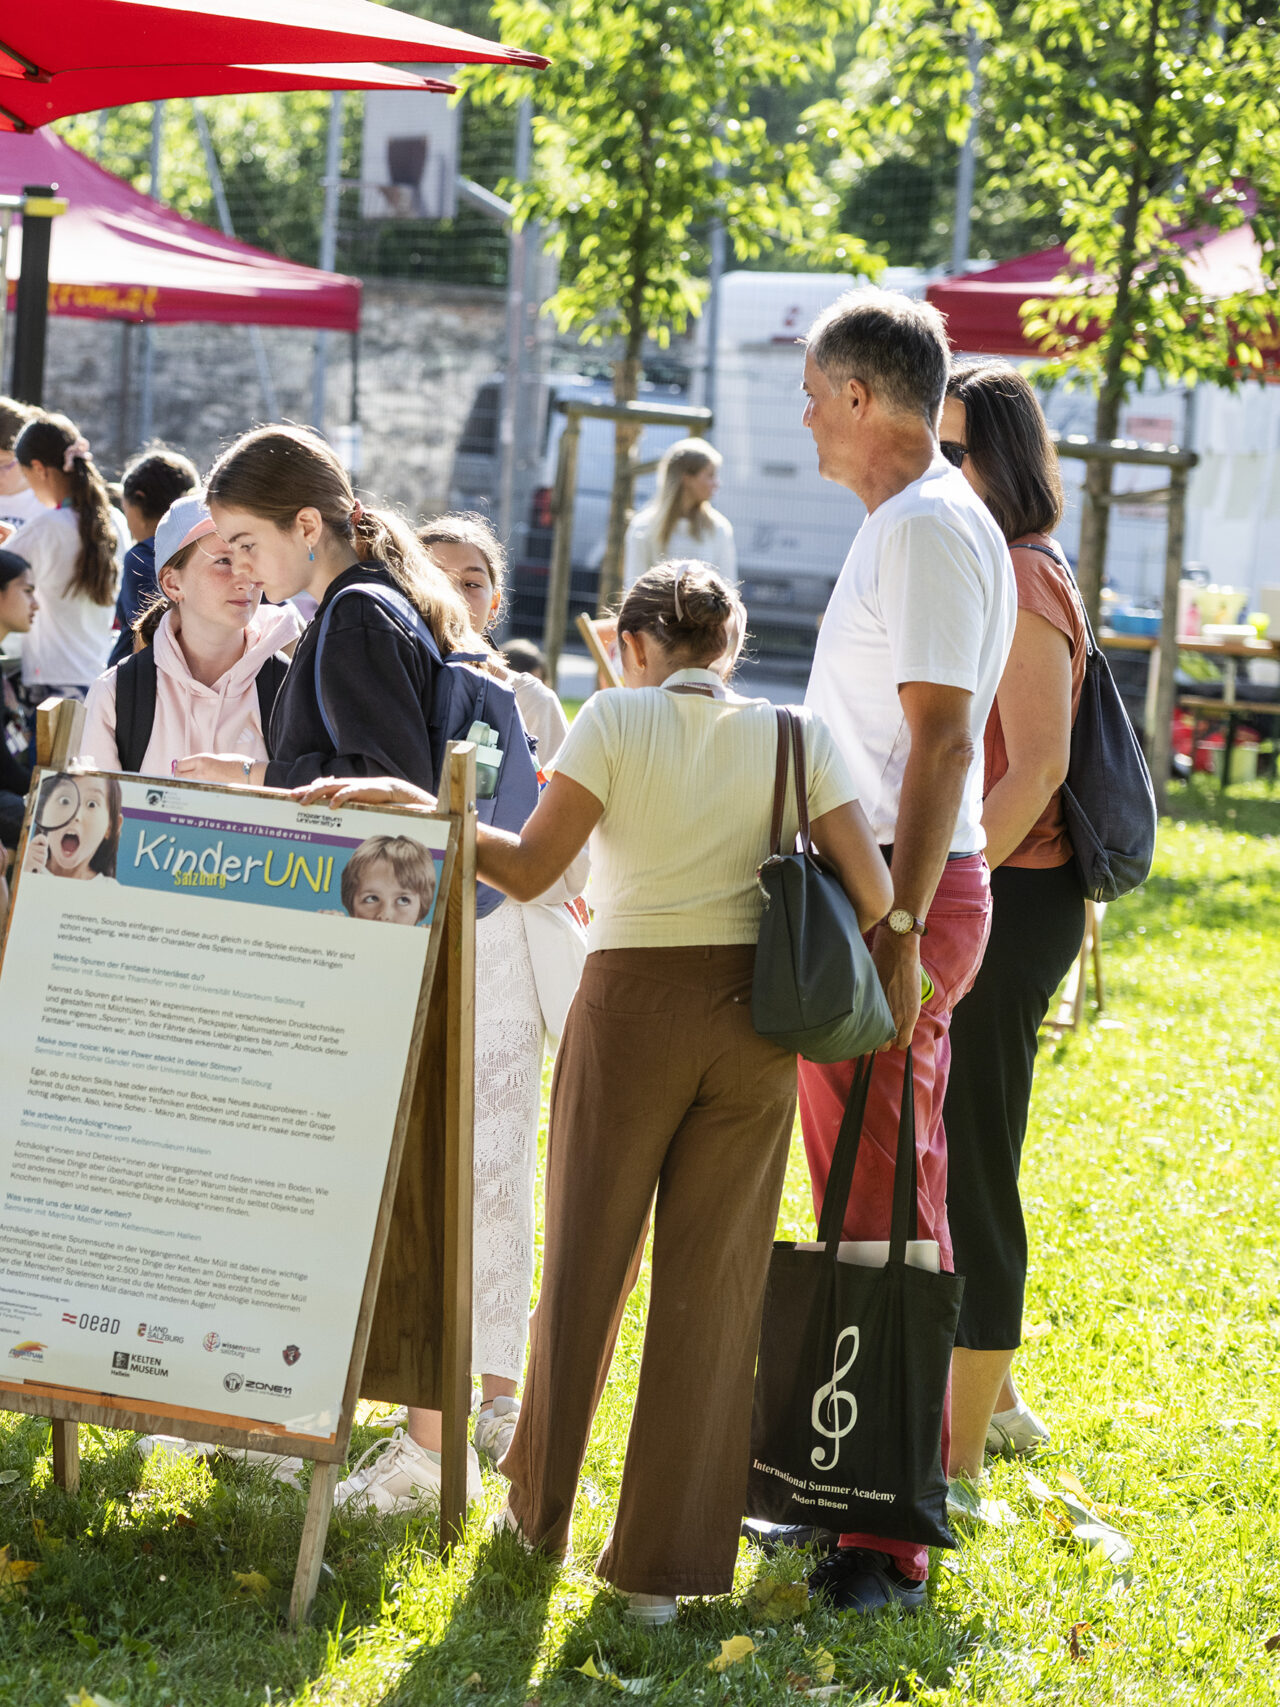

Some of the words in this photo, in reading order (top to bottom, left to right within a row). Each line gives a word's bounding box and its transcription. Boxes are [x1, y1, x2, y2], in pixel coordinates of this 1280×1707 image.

[297, 812, 342, 822] mozarteum
[170, 816, 312, 841] www.plus.ac.at/kinderuni
[134, 829, 334, 893] KinderUNI
[174, 870, 227, 889] Salzburg
[149, 1324, 169, 1334] LAND
[147, 1331, 185, 1344] SALZBURG
[131, 1354, 162, 1367] KELTEN
[129, 1364, 169, 1377] MUSEUM
[753, 1458, 807, 1490] International
[808, 1480, 851, 1495] Summer
[851, 1487, 896, 1504] Academy
[791, 1492, 816, 1506] Alden
[817, 1499, 848, 1510] Biesen
